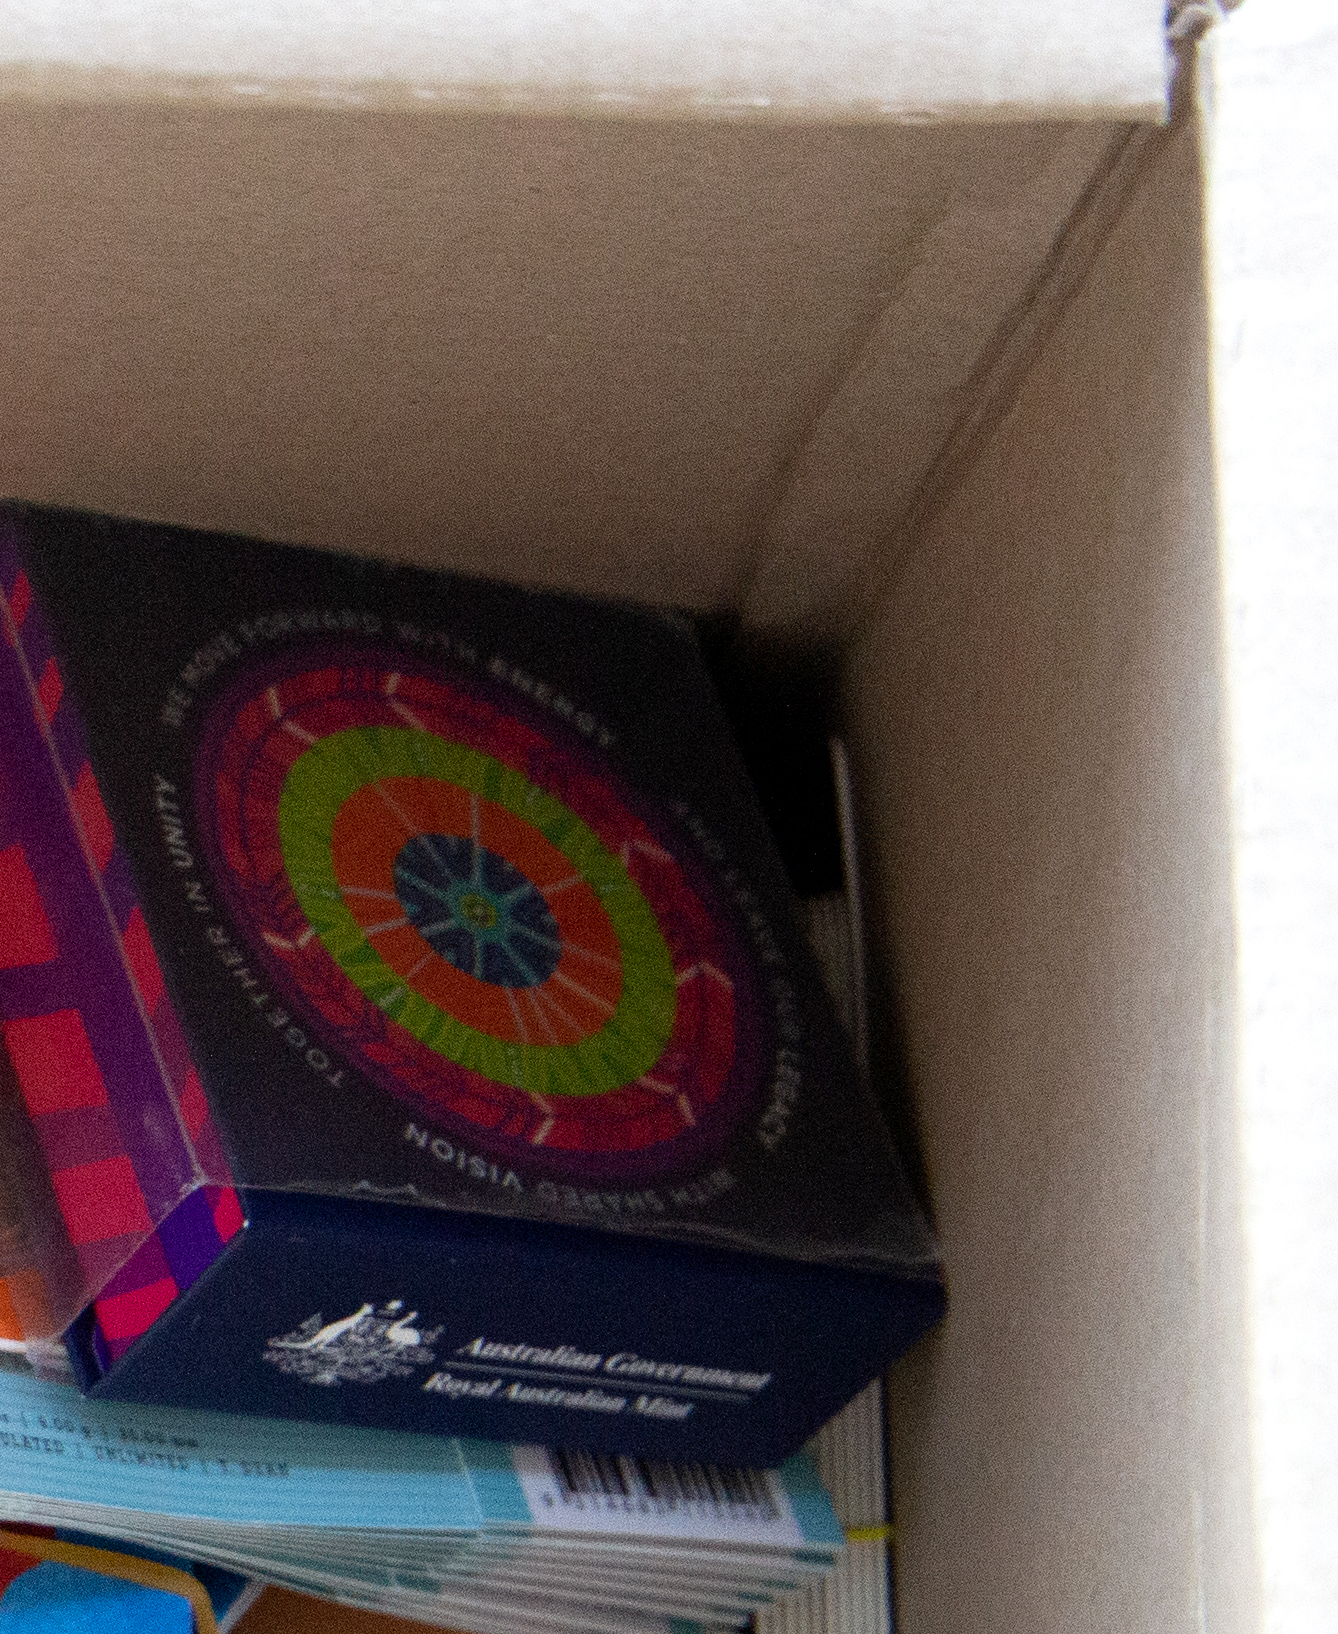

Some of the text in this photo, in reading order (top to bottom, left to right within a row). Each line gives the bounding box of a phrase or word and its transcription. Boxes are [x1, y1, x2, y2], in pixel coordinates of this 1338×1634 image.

[155, 775, 344, 1089] TOGETHER IN UNITY
[403, 1122, 523, 1191] VISION
[537, 1181, 664, 1211] SHARED
[423, 1372, 502, 1399] Royal
[506, 1382, 626, 1414] Australian
[455, 1336, 771, 1393] Australian Government
